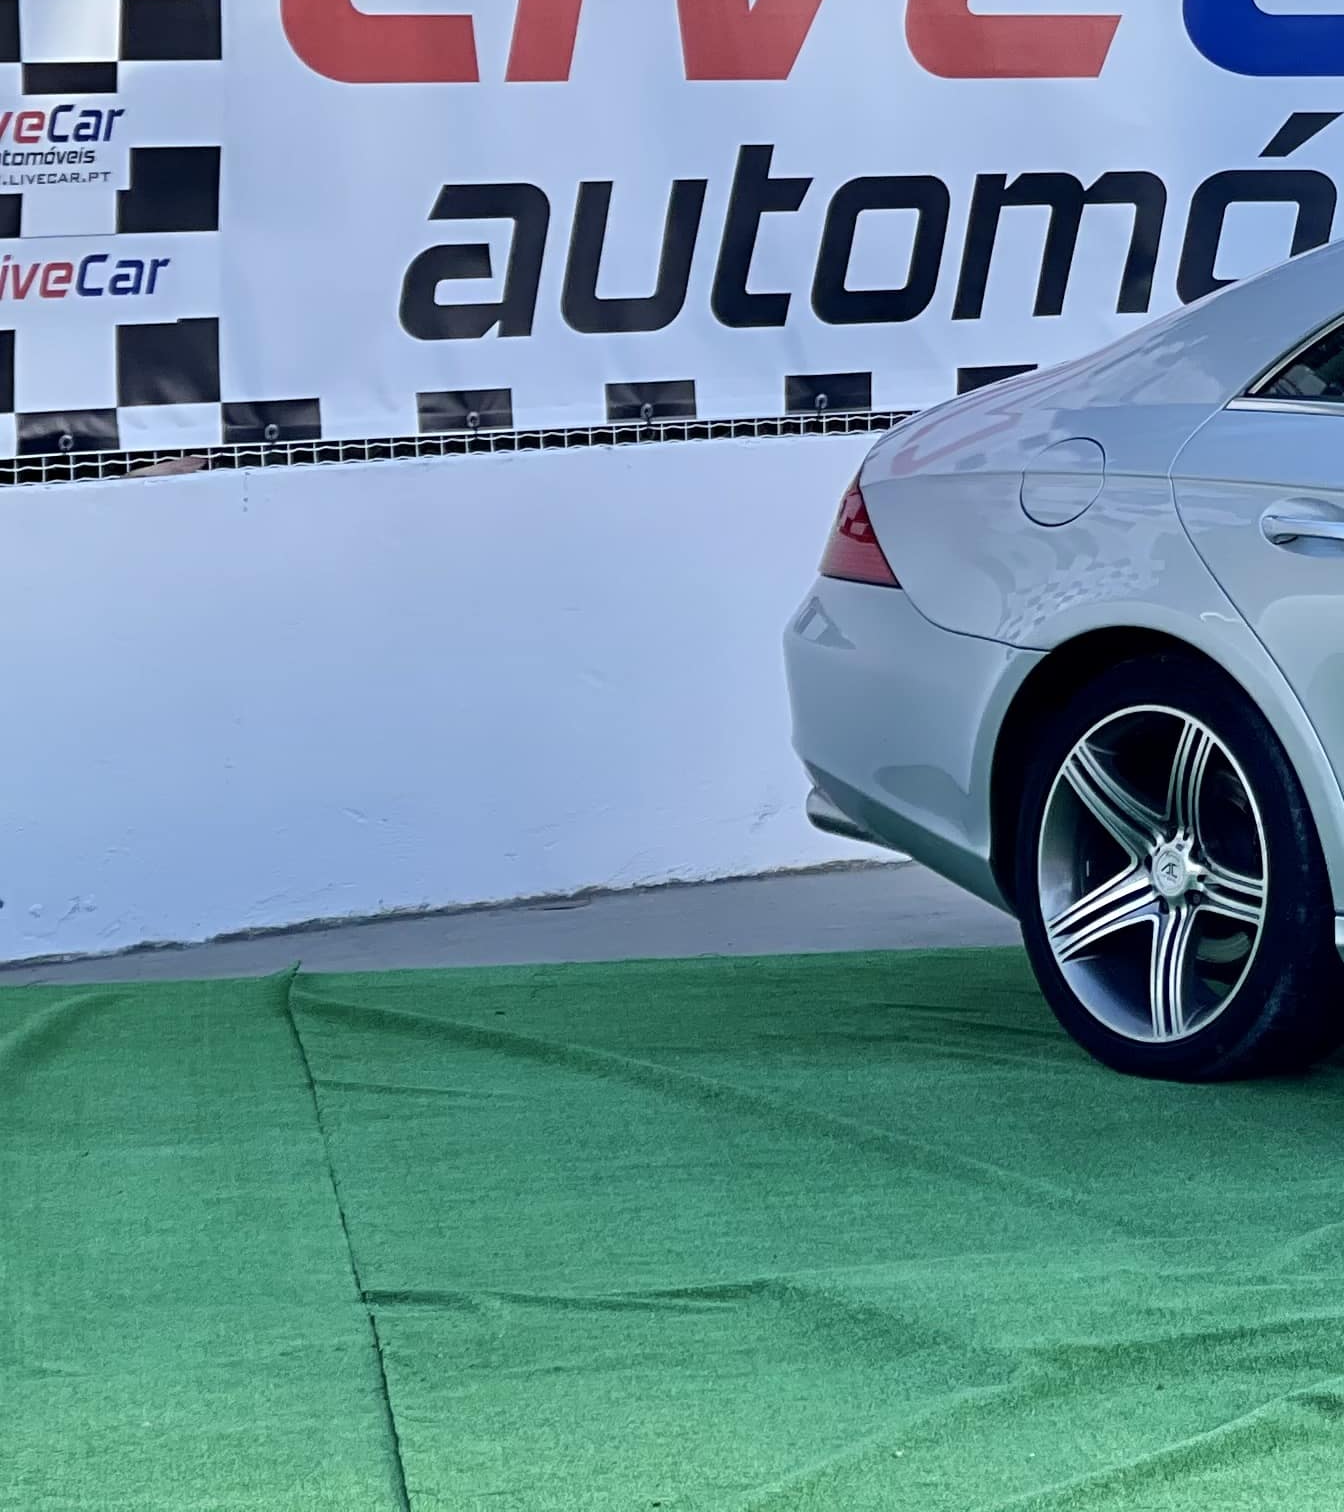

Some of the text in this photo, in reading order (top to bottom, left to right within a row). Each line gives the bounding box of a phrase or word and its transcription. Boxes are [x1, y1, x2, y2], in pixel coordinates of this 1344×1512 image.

[0, 104, 125, 143] eCar
[0, 147, 95, 166] tomóveis
[0, 172, 111, 185] .LIVECAR.PT
[0, 254, 170, 300] iveCar
